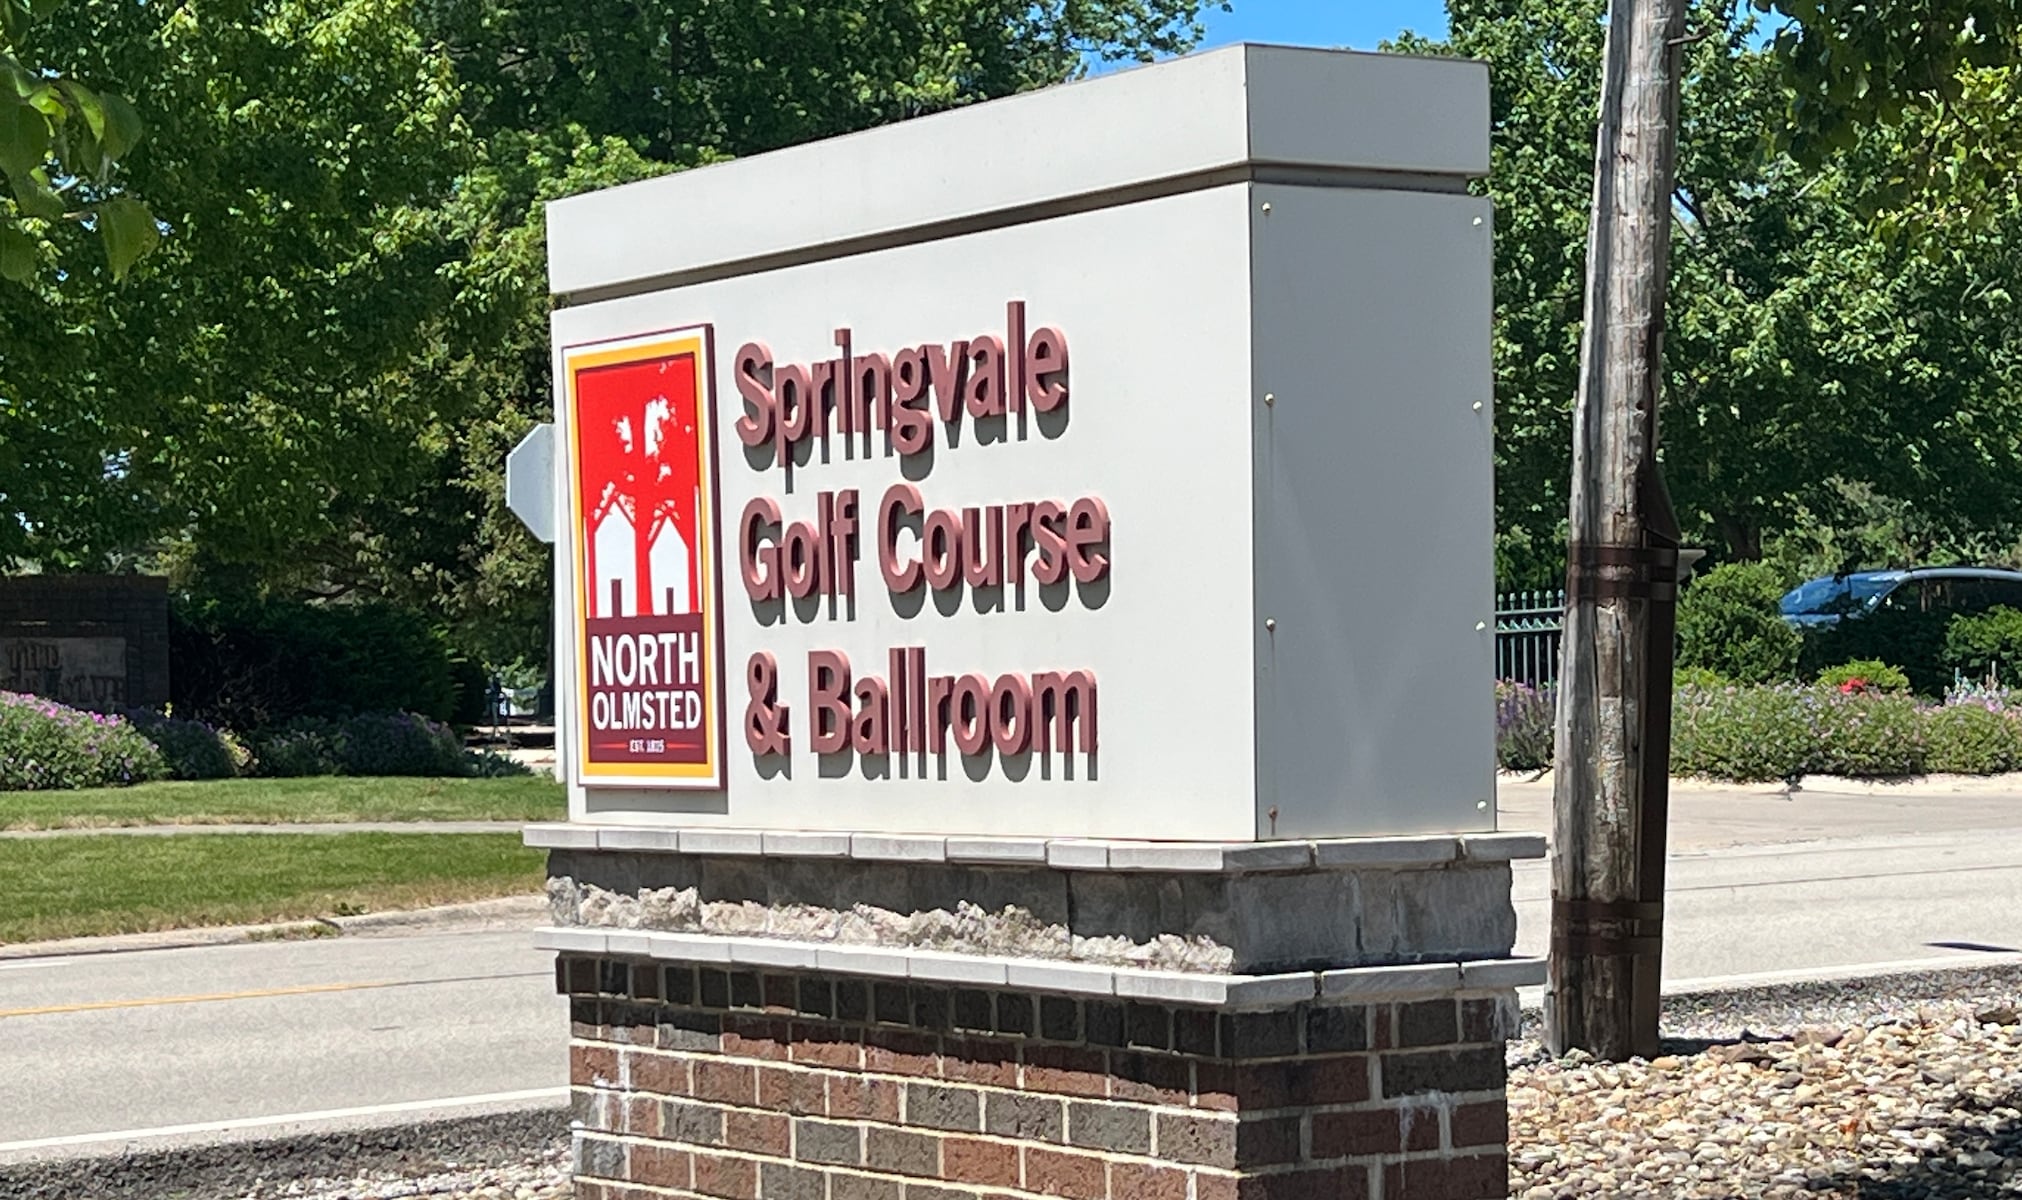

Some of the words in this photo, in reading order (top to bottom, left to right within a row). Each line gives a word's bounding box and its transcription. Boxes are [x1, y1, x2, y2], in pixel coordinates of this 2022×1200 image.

[734, 301, 1069, 468] Springvale
[739, 490, 859, 600] Golf
[878, 484, 1110, 592] Course
[591, 632, 699, 686] NORTH
[592, 691, 702, 730] OLMSTED
[745, 651, 790, 756] &
[808, 646, 1098, 756] Ballroom
